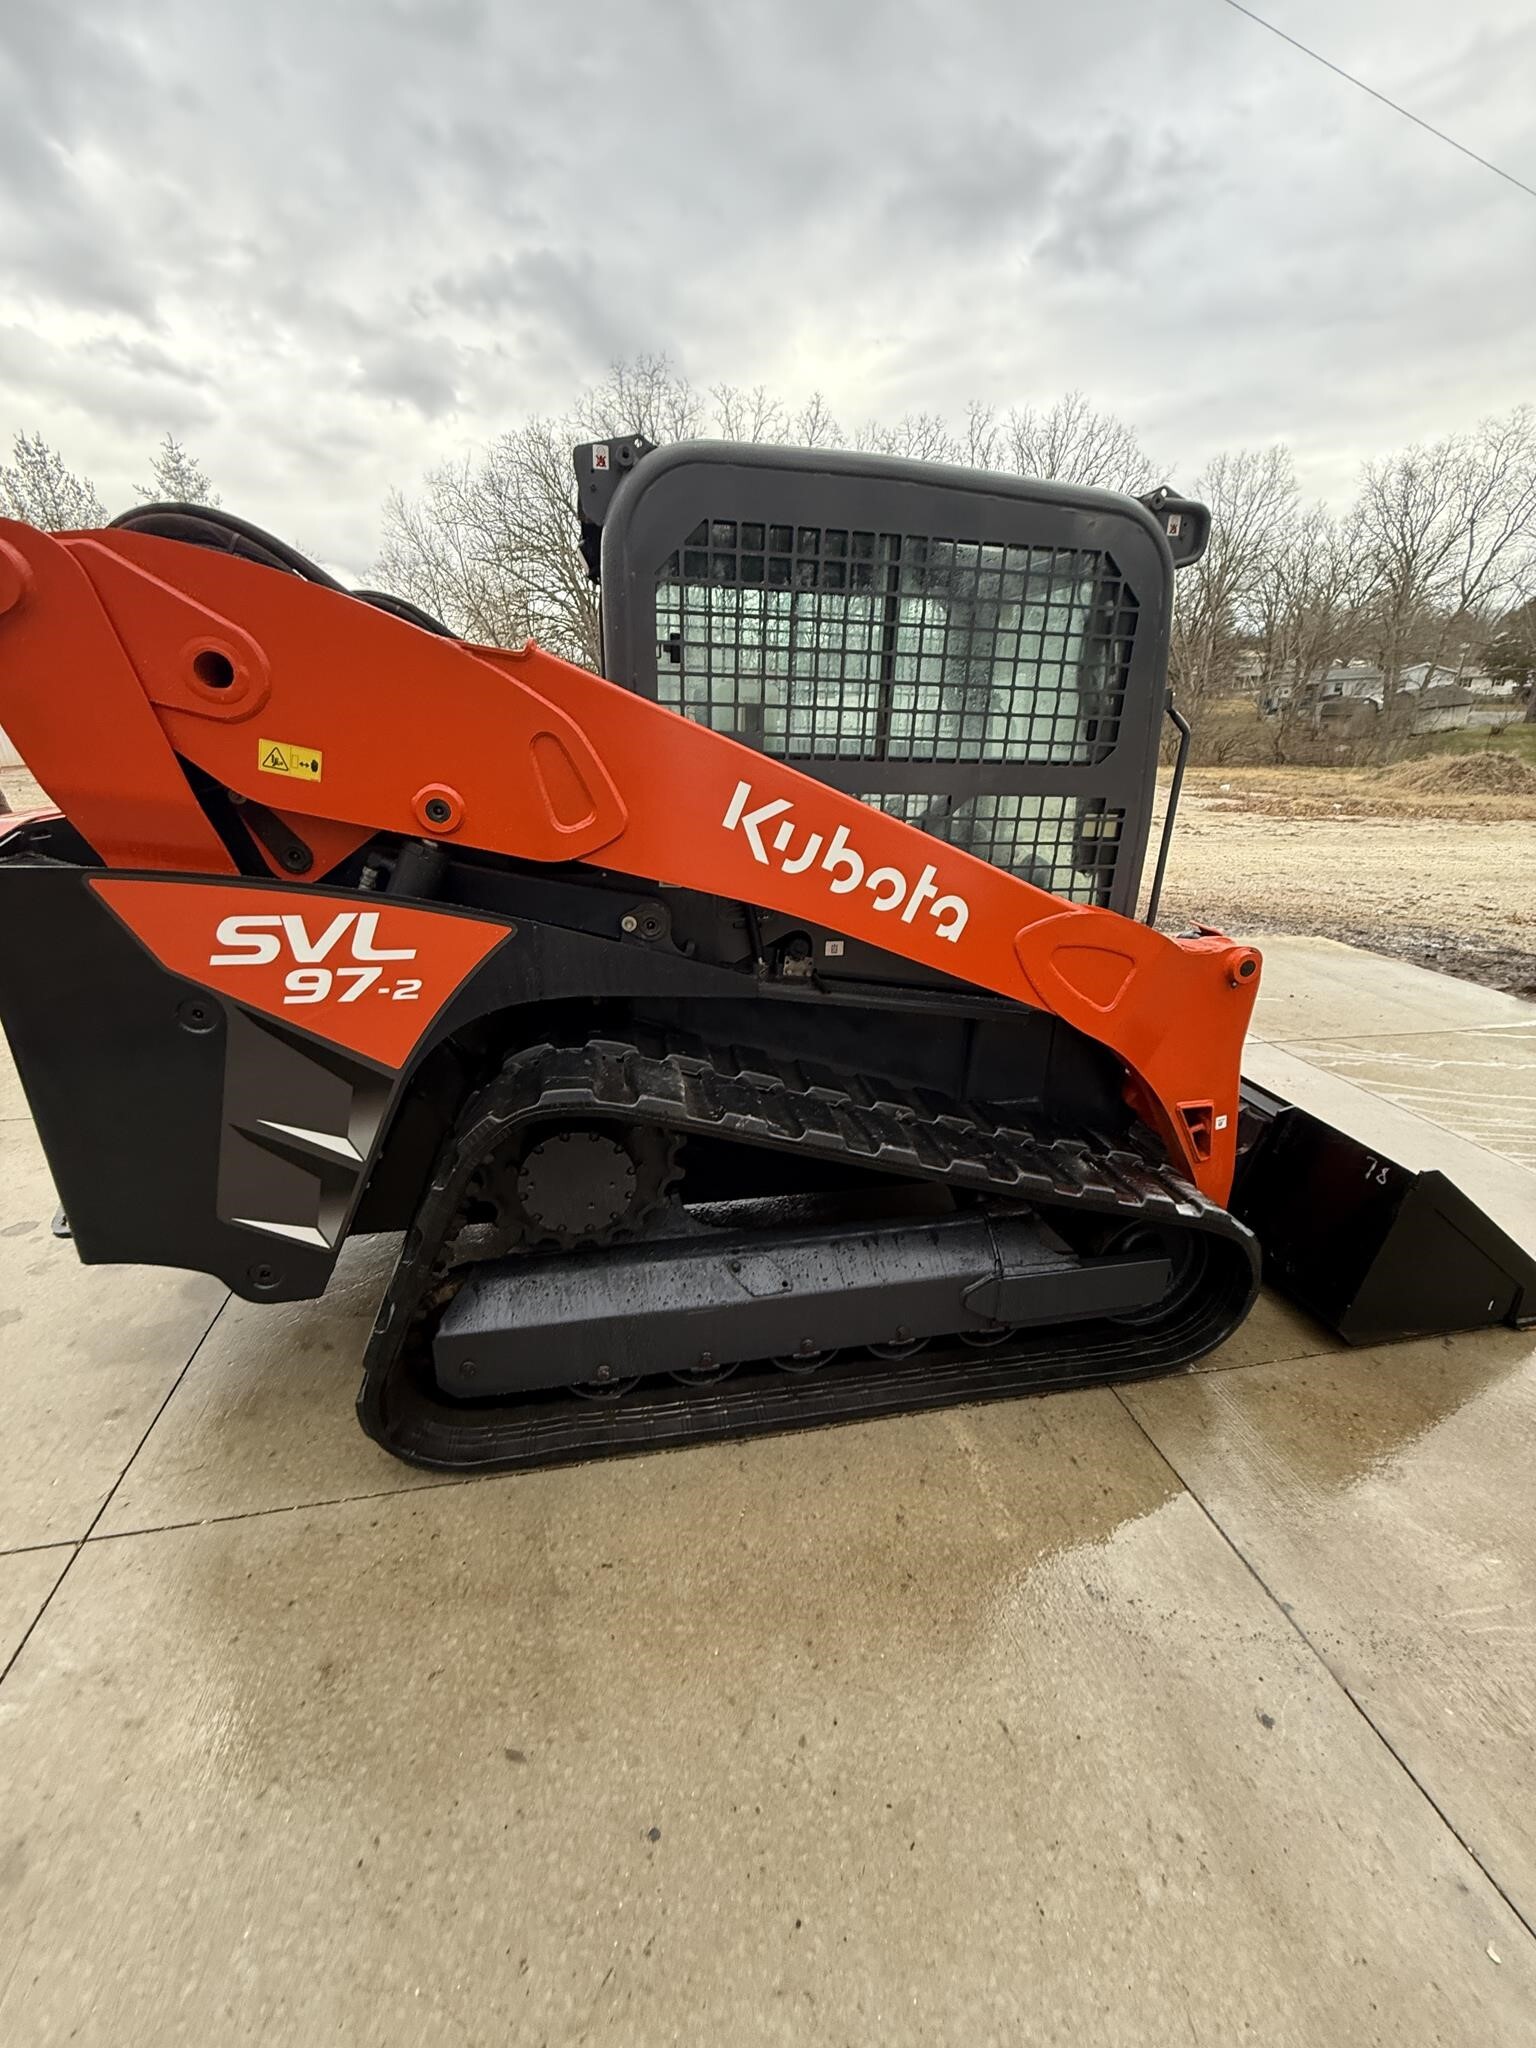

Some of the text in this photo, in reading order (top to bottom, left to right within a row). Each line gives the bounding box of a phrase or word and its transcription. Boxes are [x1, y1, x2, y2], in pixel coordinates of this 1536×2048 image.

[722, 780, 969, 943] Kubota
[209, 912, 417, 966] SVL
[283, 967, 422, 1004] 97-2
[1365, 1155, 1390, 1185] 78
